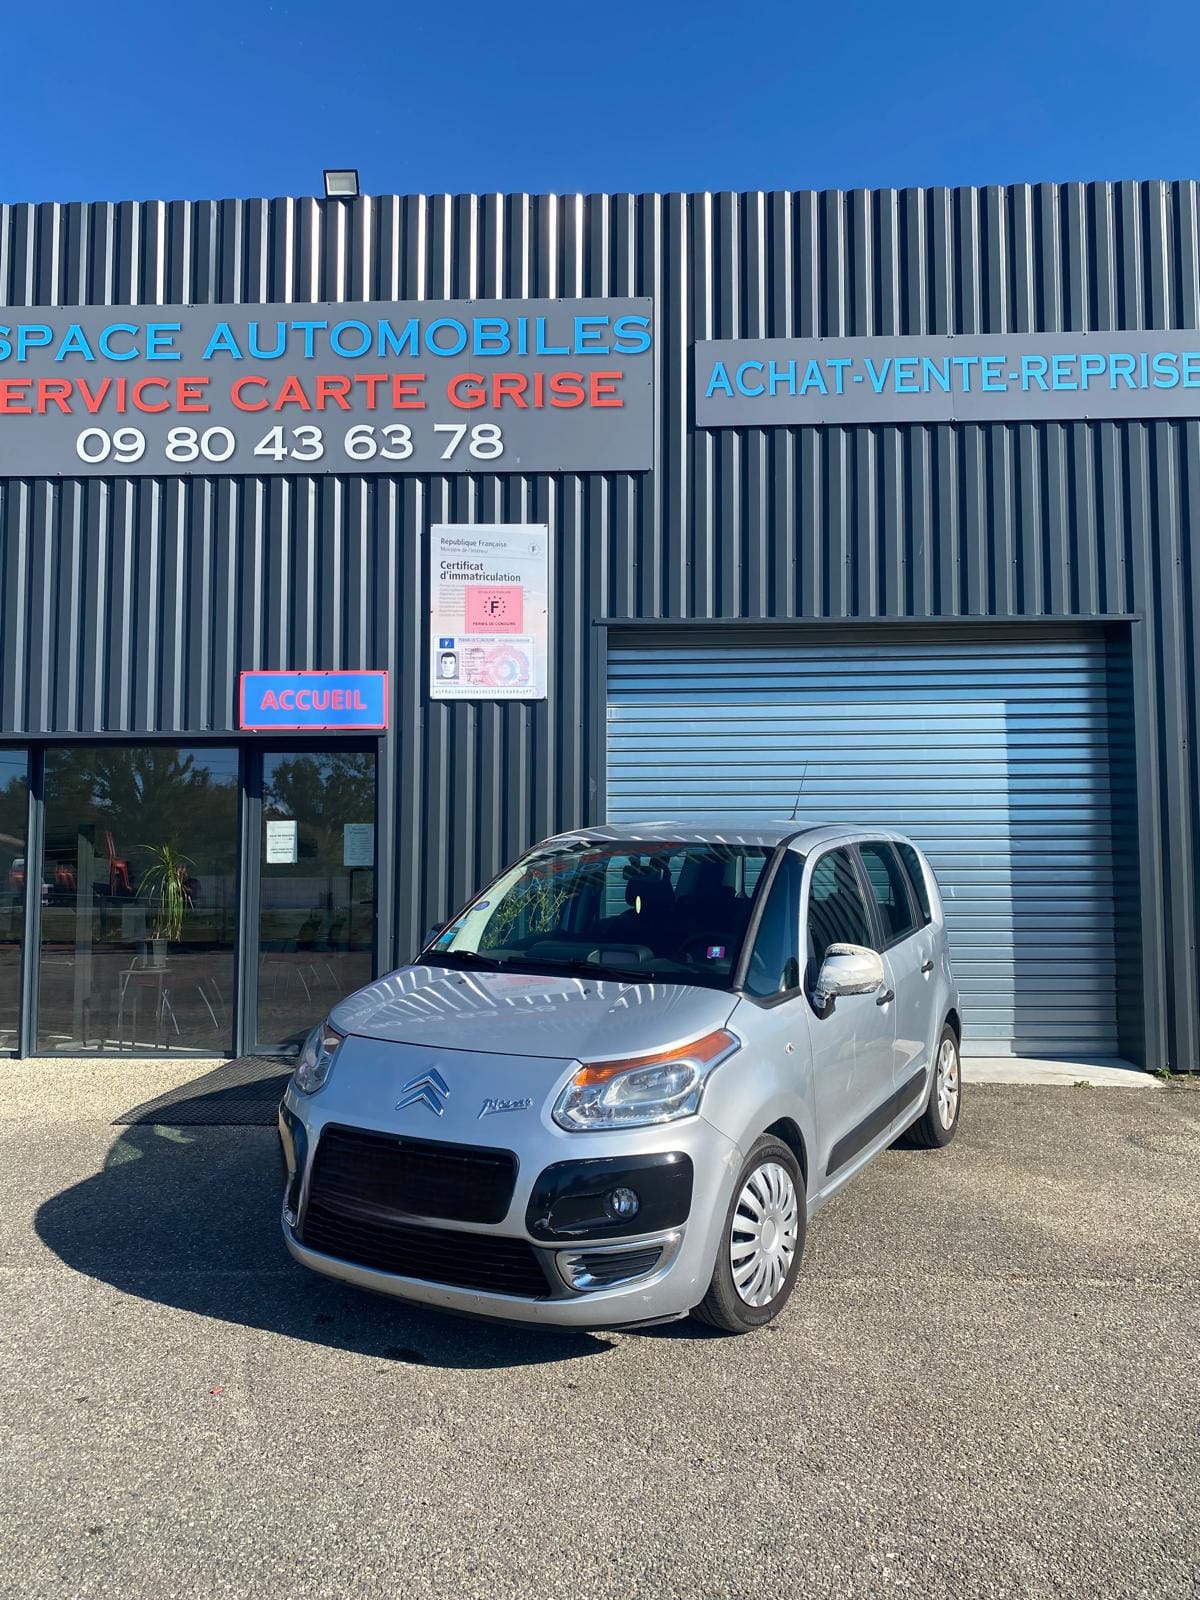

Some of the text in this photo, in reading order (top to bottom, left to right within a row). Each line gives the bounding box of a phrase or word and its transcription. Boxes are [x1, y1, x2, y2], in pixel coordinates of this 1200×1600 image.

[202, 315, 652, 361] AUTOMOBILES
[0, 371, 624, 414] ERVICE CARTE GRISE
[76, 423, 504, 463] 09 80 43 63 78
[440, 560, 484, 571] Certificat
[440, 571, 521, 582] d'immatriculation
[490, 600, 500, 613] F
[260, 689, 368, 710] ACCUEIL
